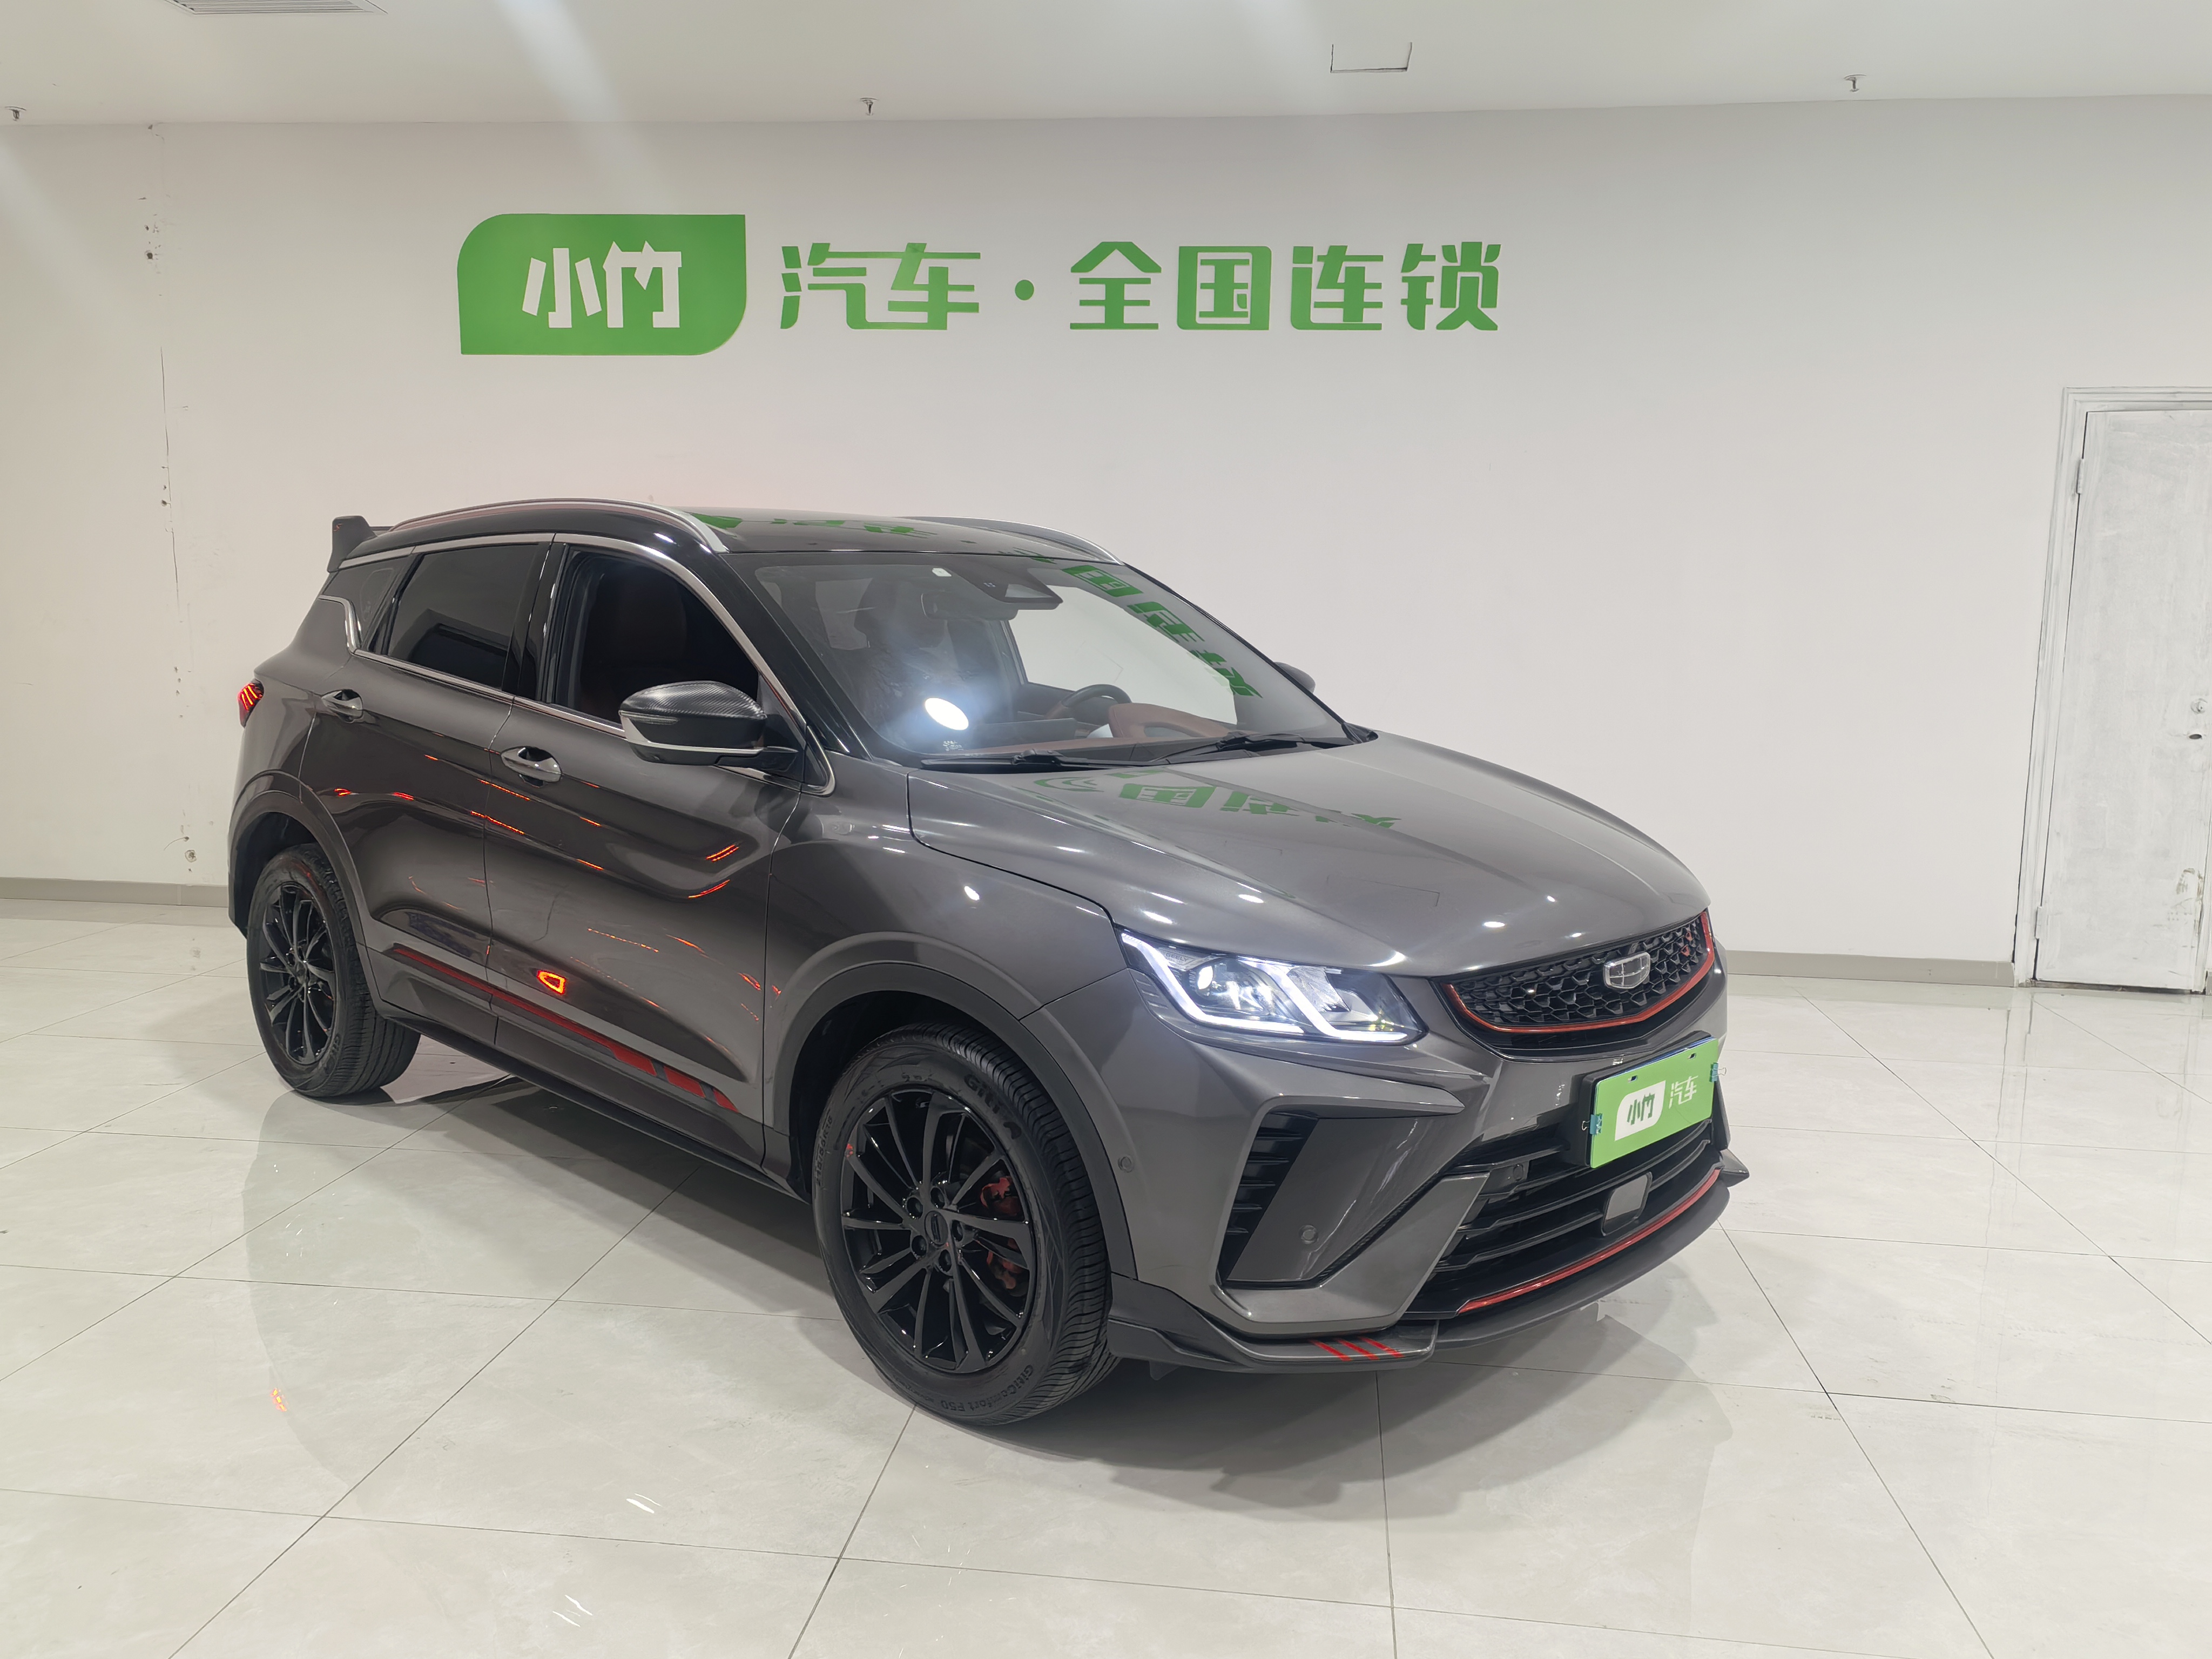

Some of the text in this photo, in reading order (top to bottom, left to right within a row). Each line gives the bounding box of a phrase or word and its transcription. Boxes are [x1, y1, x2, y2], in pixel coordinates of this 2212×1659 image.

[521, 240, 683, 328] 小竹
[1165, 952, 1189, 962] GEELY
[1627, 1076, 1698, 1125] 小竹 汽车
[940, 1400, 966, 1412] F50
